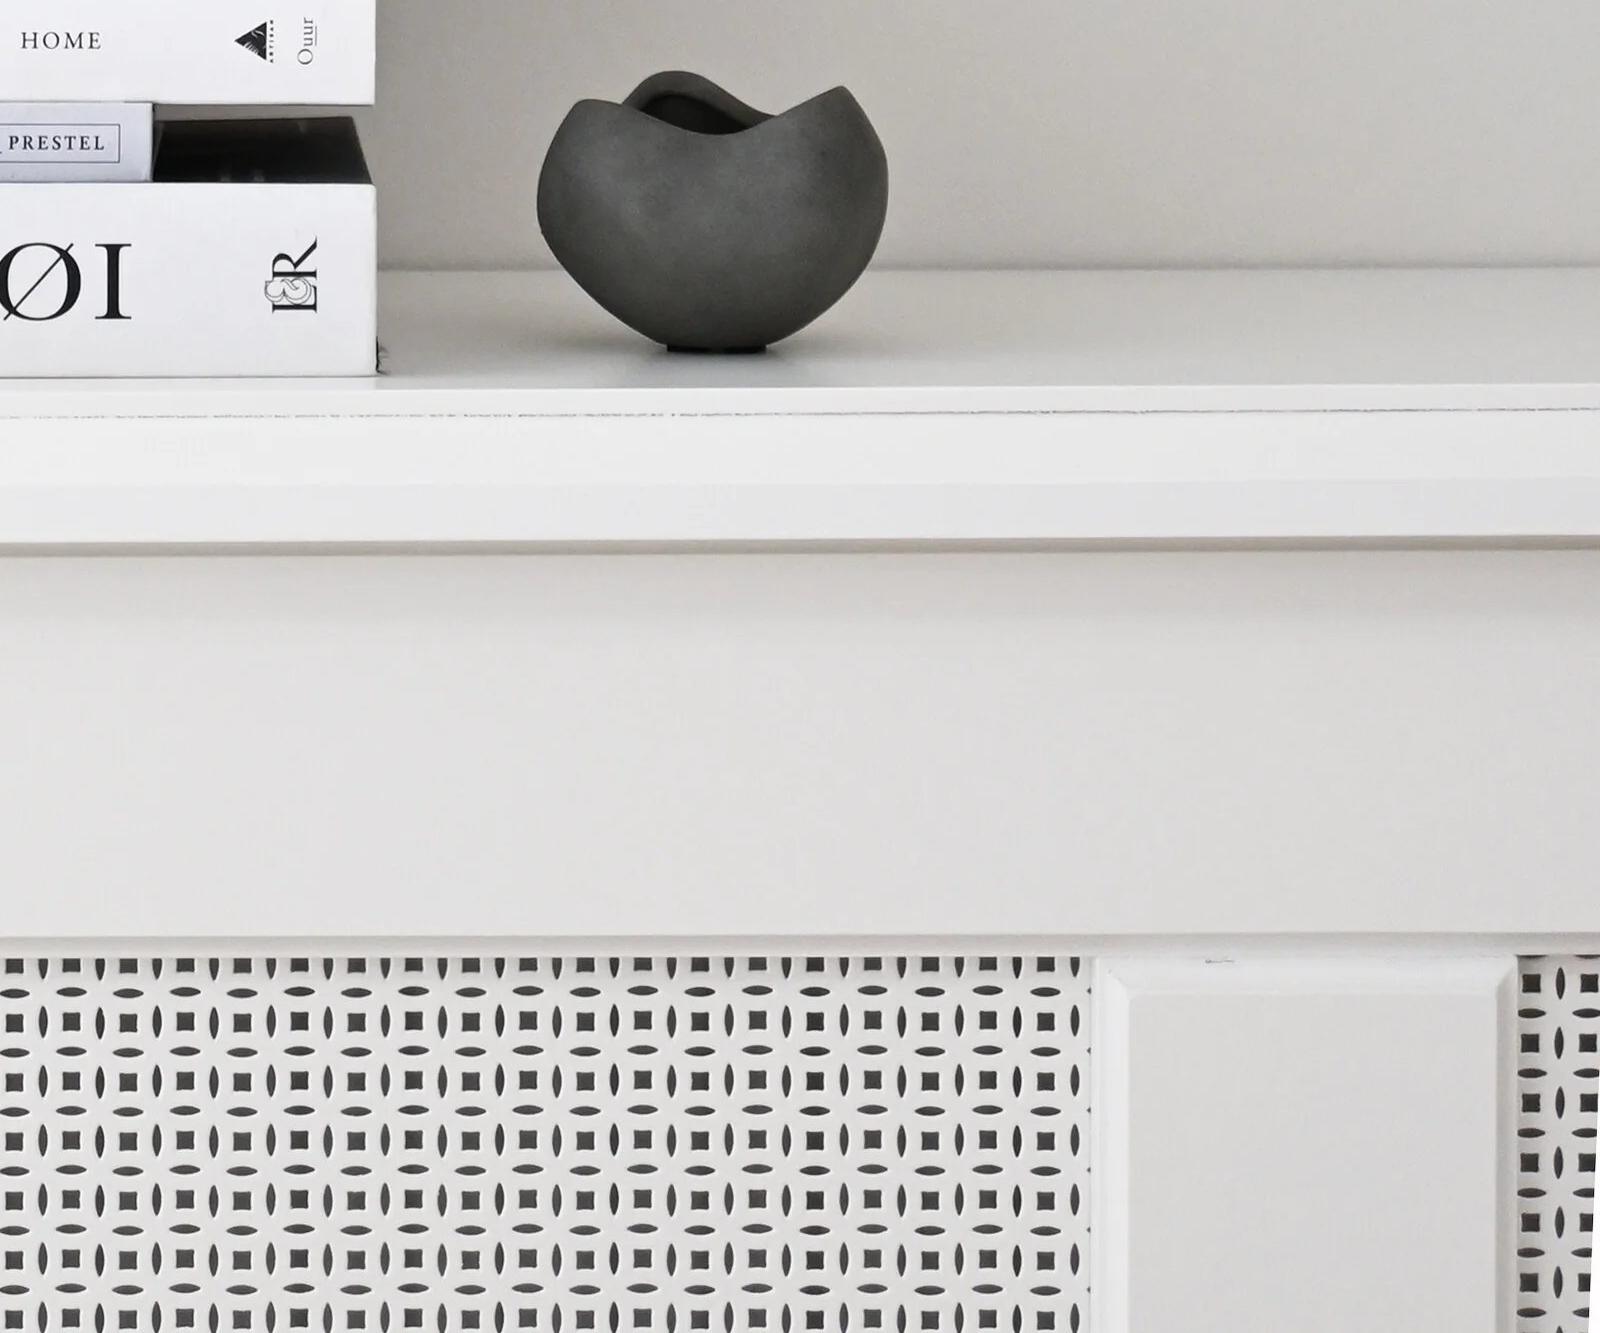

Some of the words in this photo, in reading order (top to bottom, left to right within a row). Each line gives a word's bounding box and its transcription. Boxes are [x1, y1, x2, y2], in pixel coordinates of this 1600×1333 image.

[20, 31, 102, 50] HOME
[296, 16, 314, 66] Ouur
[8, 135, 105, 151] PRESTEL
